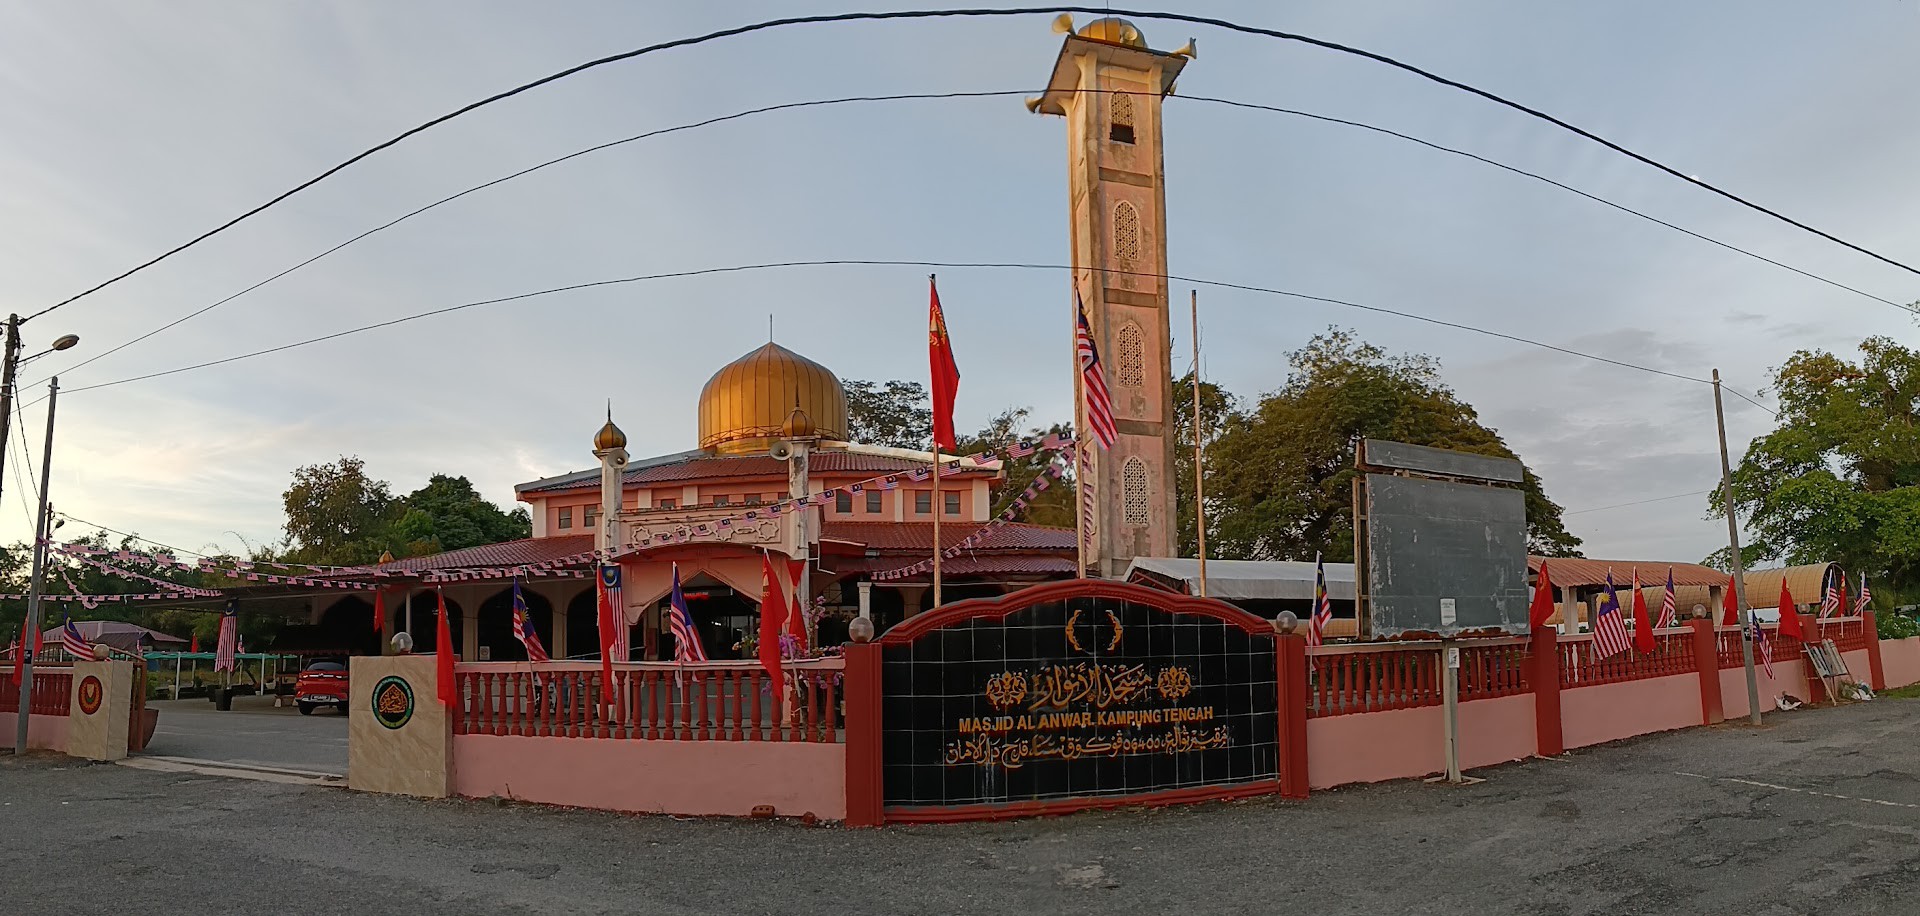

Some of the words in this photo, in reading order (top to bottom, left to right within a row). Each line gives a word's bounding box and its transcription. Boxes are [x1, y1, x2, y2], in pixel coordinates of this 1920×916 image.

[958, 715, 1015, 733] MASJID
[1016, 714, 1036, 730] AL
[1097, 709, 1162, 727] KAMPUNG
[1162, 705, 1214, 723] TENGAH
